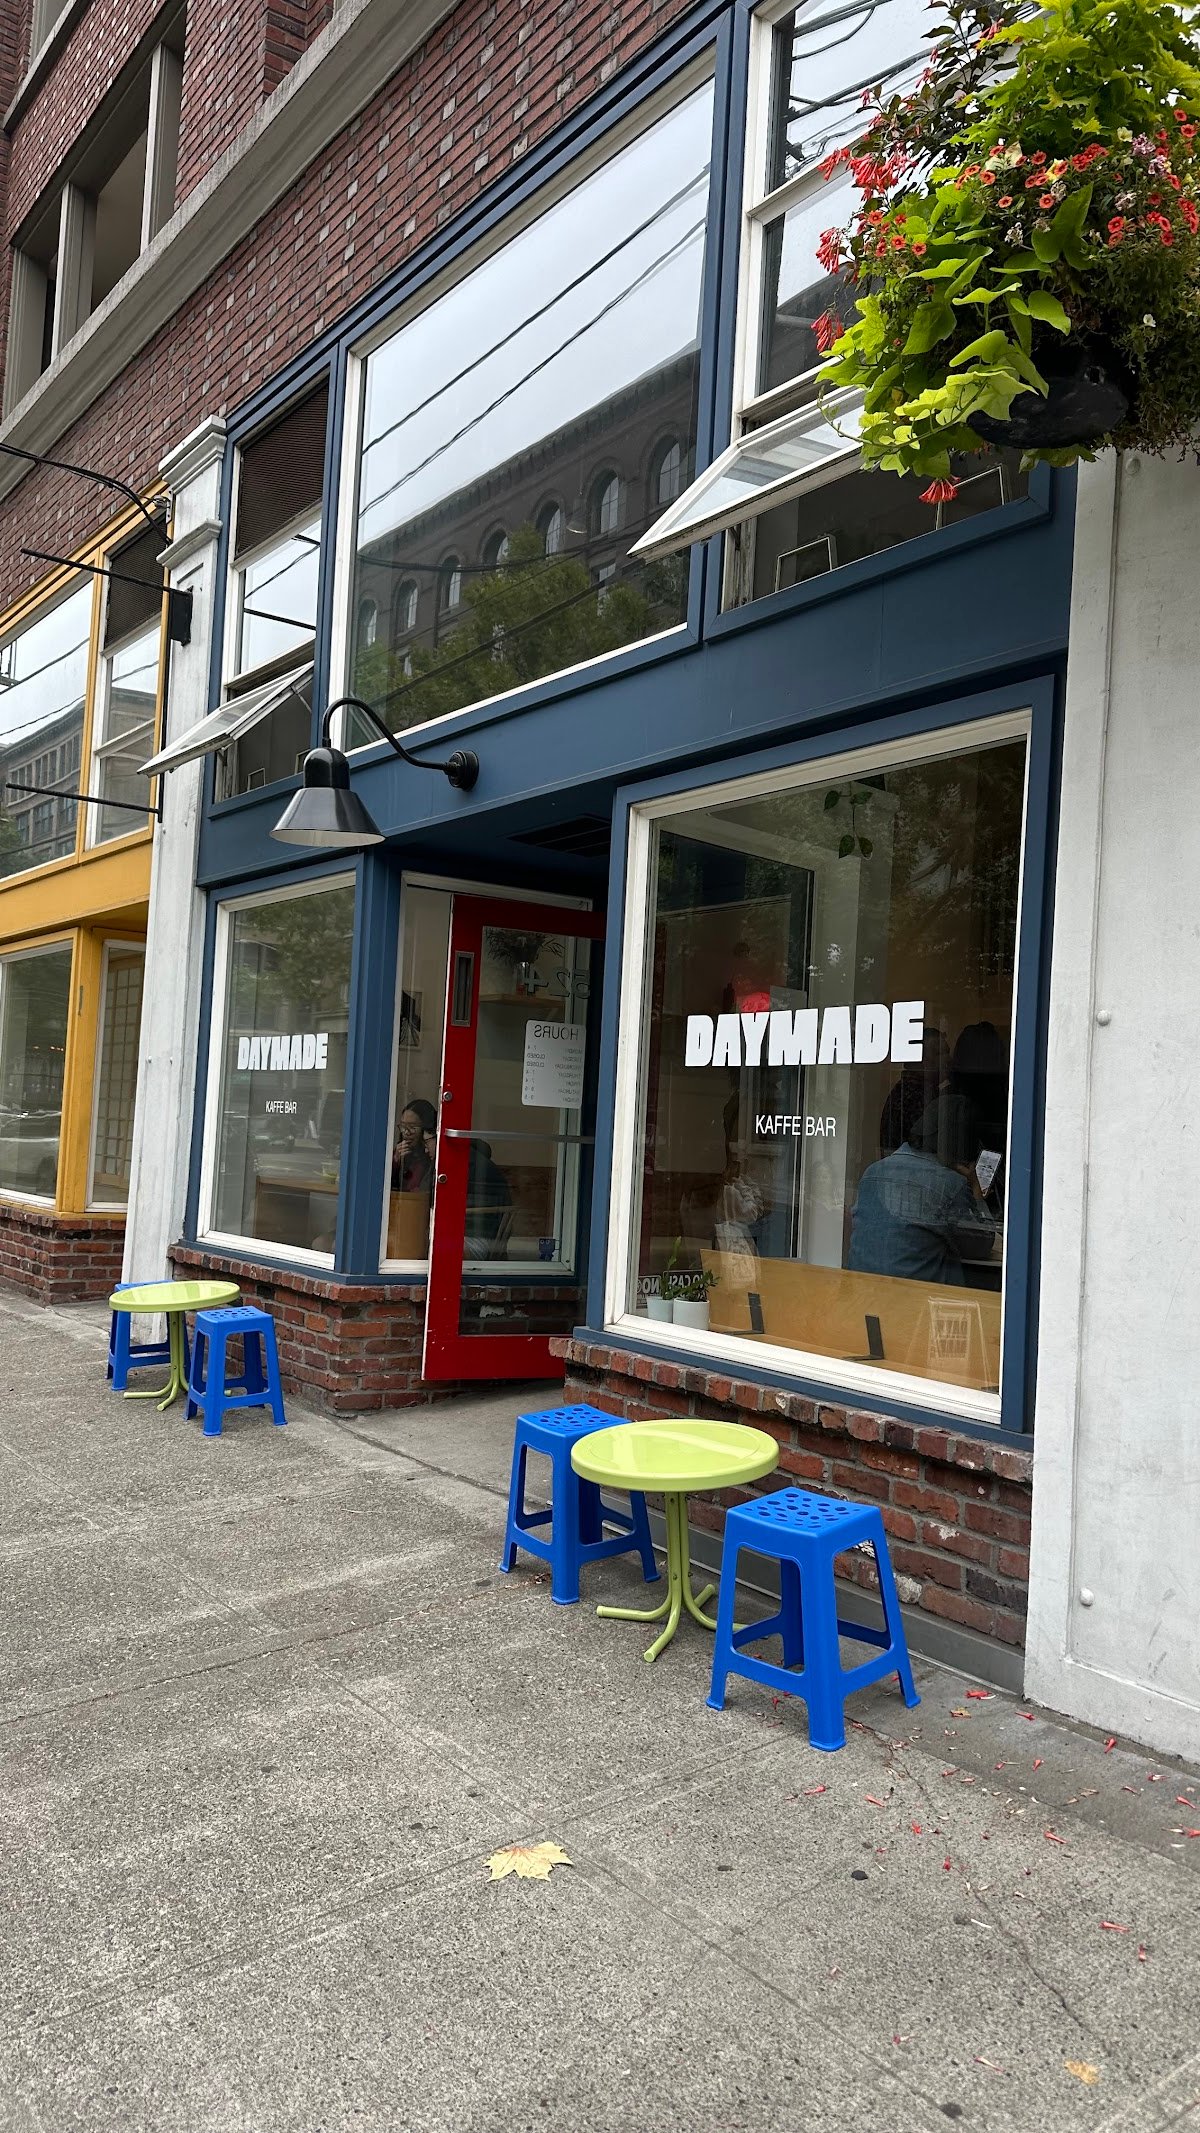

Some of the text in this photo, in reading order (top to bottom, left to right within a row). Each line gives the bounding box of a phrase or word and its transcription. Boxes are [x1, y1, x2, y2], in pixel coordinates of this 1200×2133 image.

[685, 1001, 924, 1067] DAYMADE
[237, 1033, 328, 1070] DAYMADE
[265, 1101, 297, 1114] KAFFE BAR
[755, 1114, 836, 1137] KAFFE BAR
